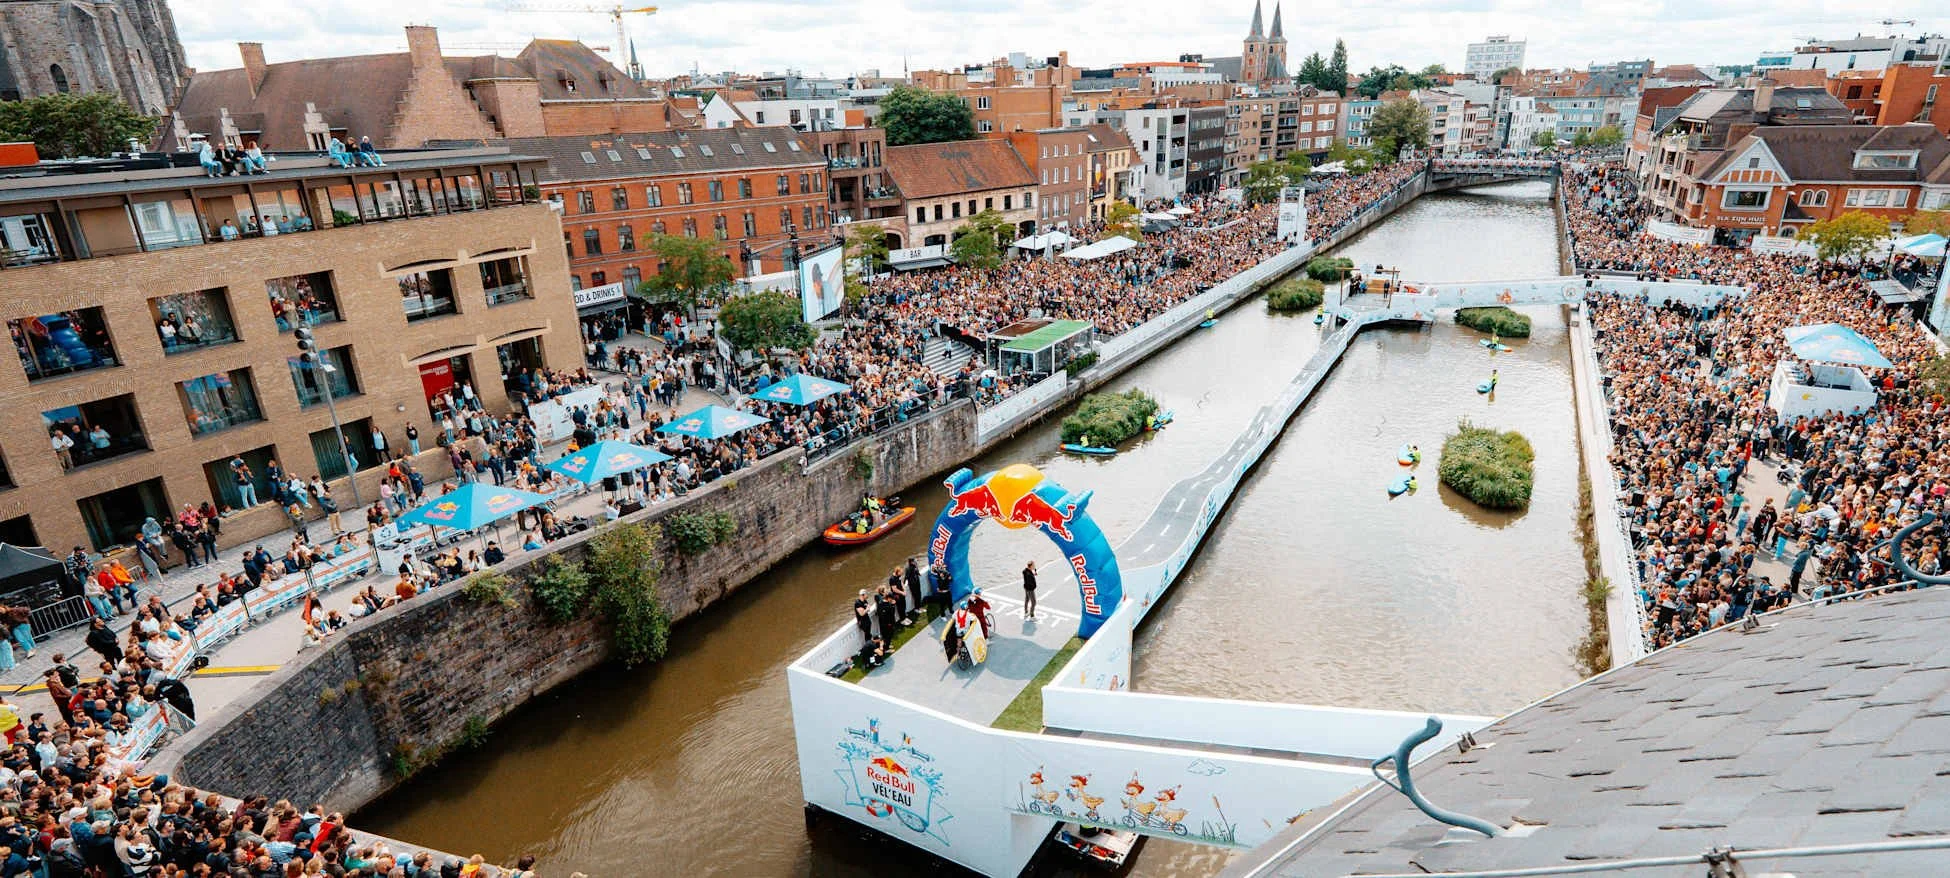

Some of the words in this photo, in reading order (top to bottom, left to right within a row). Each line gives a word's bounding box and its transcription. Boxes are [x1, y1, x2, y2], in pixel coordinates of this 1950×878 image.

[910, 249, 921, 258] BAR
[586, 293, 591, 301] &
[592, 288, 615, 300] DRINKS
[1071, 554, 1095, 585] Red
[1083, 586, 1101, 614] Bull
[867, 766, 890, 785] Red
[892, 775, 915, 794] Bull
